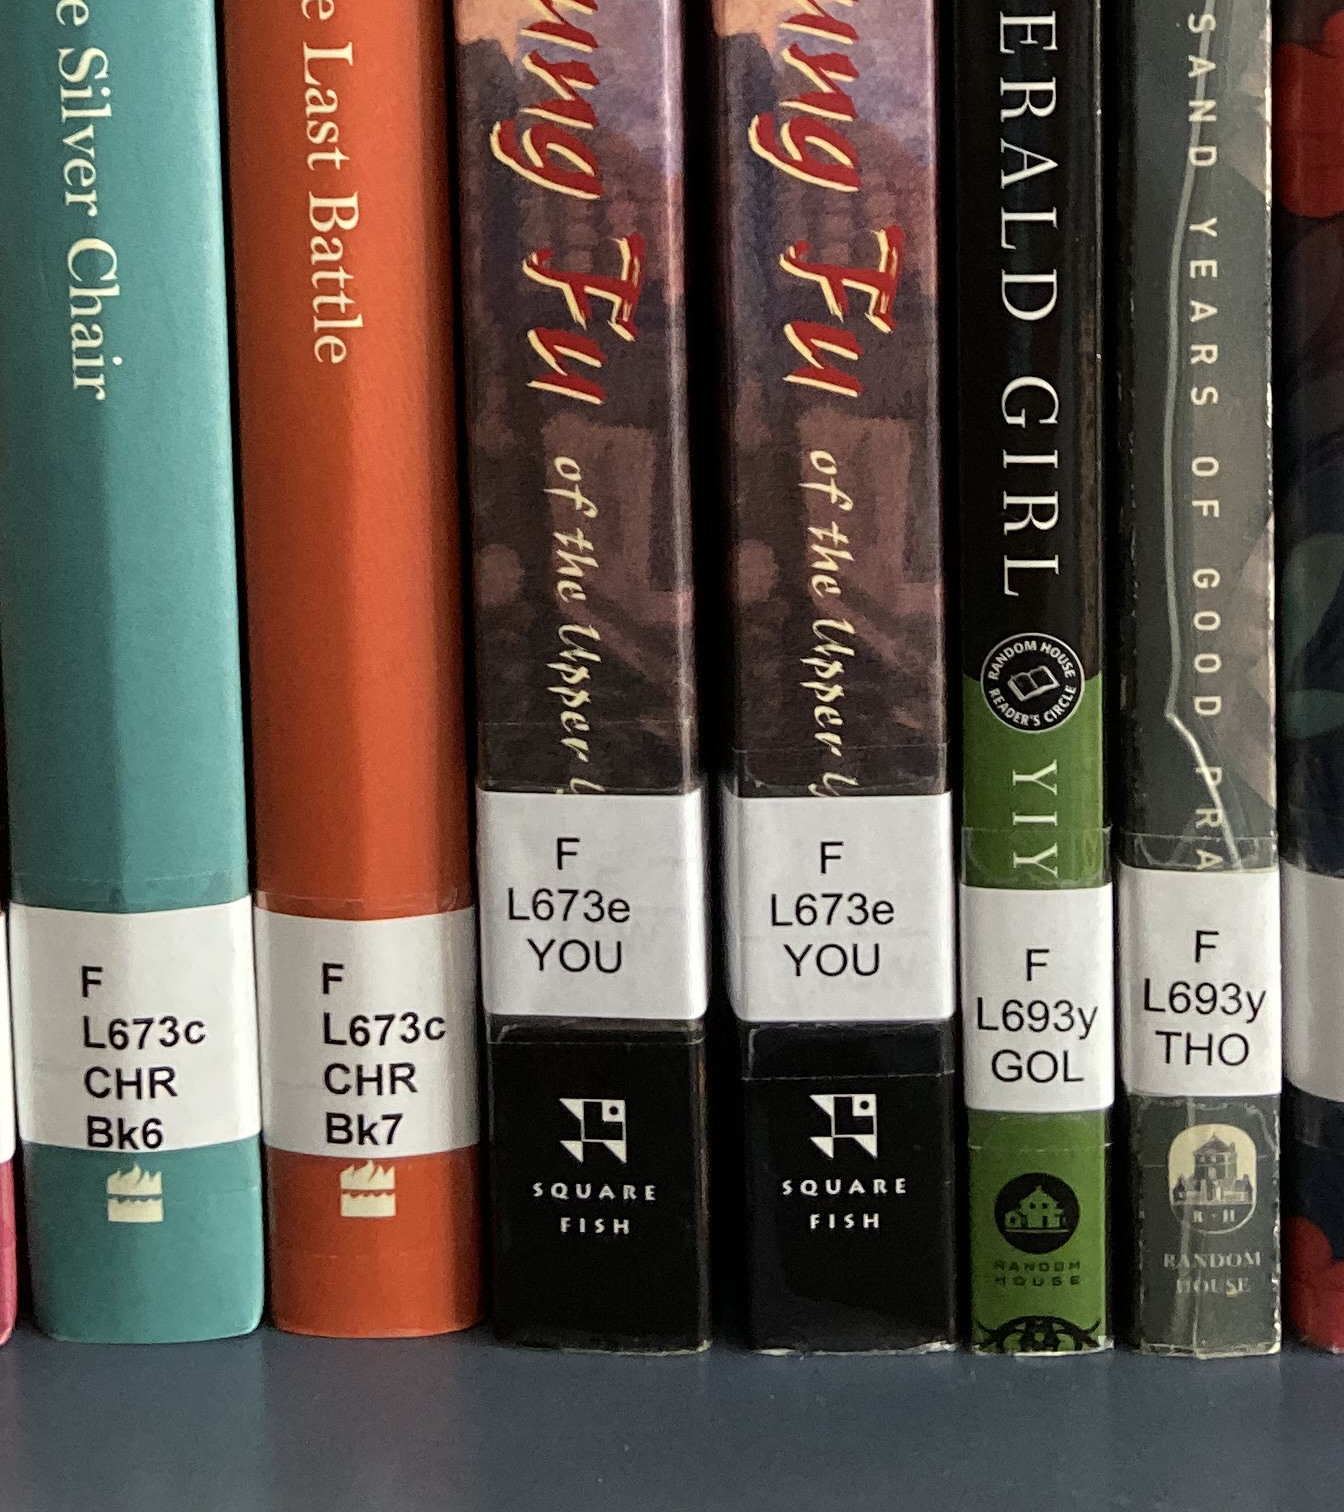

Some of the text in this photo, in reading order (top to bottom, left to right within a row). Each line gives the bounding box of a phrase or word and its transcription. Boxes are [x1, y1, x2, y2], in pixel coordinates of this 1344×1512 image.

[303, 40, 364, 364] Last Battle
[57, 47, 123, 401] Silver Chair
[522, 231, 646, 405] Fu
[779, 224, 906, 397] Fu
[1189, 216, 1219, 405] YEARS
[1001, 375, 1060, 597] GIRL
[553, 528, 599, 602] the
[1192, 568, 1222, 717] GOOD
[987, 640, 1076, 681] RANDOM HOUSE
[546, 623, 600, 762] Upper
[800, 618, 855, 757] Upper
[1043, 685, 1077, 723] CIRCLE
[821, 841, 844, 874] F
[508, 888, 630, 923] L673e
[771, 892, 895, 927] L673e
[527, 939, 623, 973] YOU
[783, 943, 881, 977] YOU
[321, 963, 344, 994] F
[977, 996, 1098, 1039] L693y
[1144, 979, 1266, 1023] L693y
[323, 1012, 446, 1046] L673c
[1156, 1030, 1250, 1067] THO
[324, 1062, 418, 1096] CHR
[992, 1050, 1084, 1083] GOL
[87, 1116, 163, 1149] Bk6
[326, 1113, 403, 1145] Bk7
[532, 1183, 657, 1201] SQUARE
[782, 1178, 907, 1196] SQUARE
[560, 1218, 630, 1234] FISH
[810, 1213, 880, 1230] FISH
[1164, 1252, 1261, 1268] RANDOM
